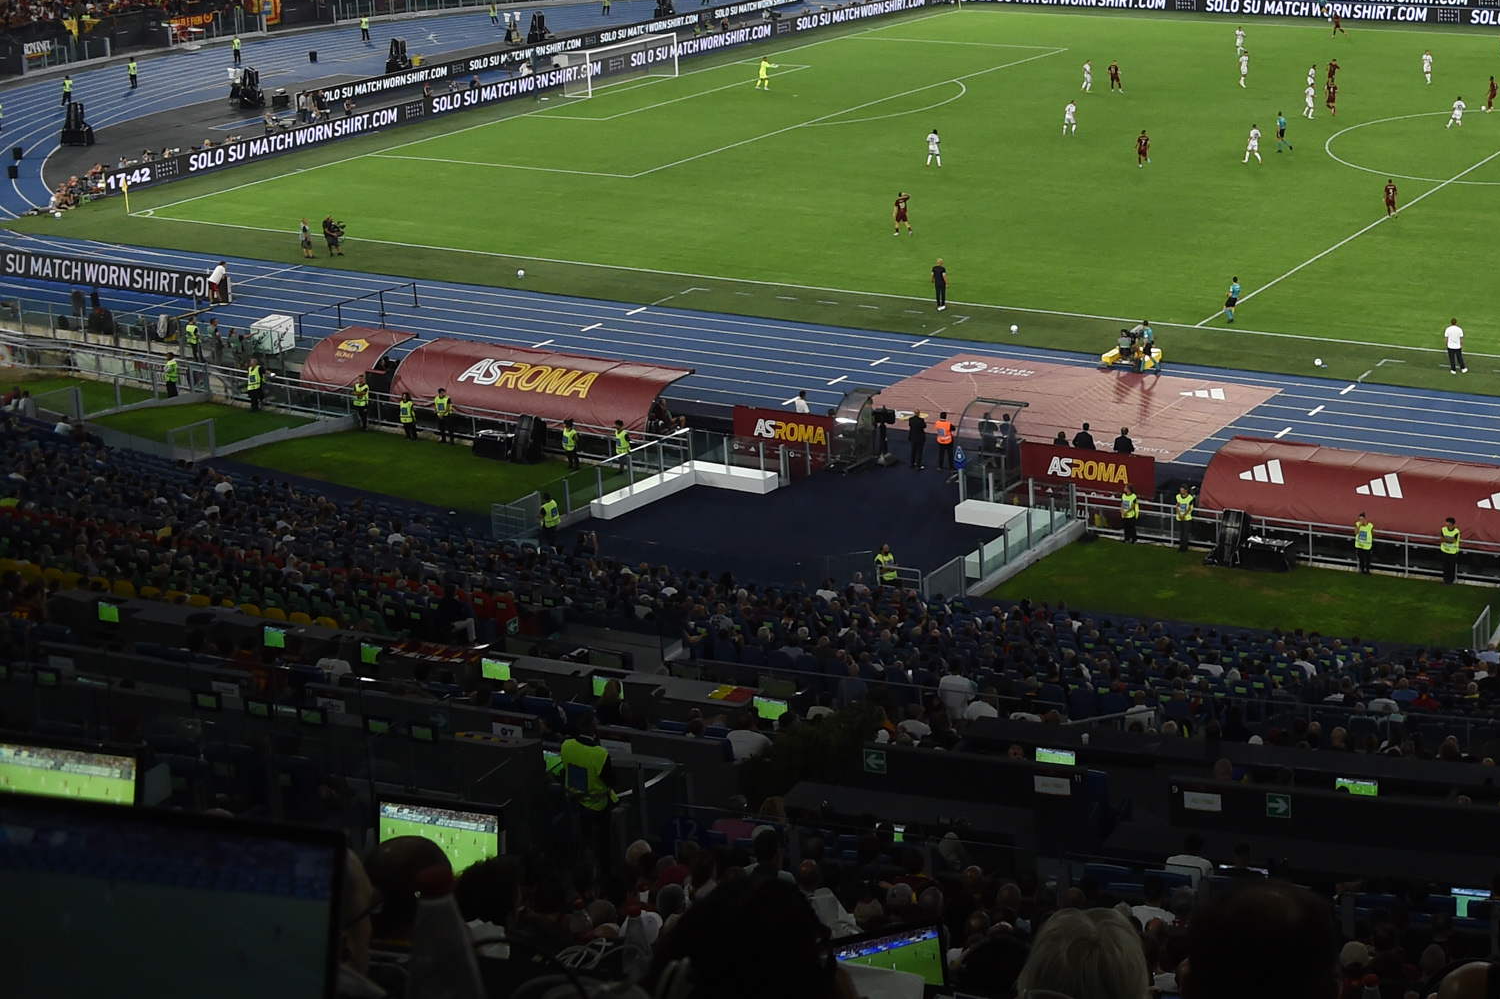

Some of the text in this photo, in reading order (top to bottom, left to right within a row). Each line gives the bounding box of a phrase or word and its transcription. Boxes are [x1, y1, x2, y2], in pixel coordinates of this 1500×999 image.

[1243, 0, 1260, 14] SU
[796, 15, 818, 30] SOLO
[820, 12, 831, 24] SU
[432, 94, 460, 113] SOLO
[464, 89, 478, 104] SU
[189, 150, 224, 171] SOLO
[228, 144, 246, 162] SU
[107, 168, 151, 190] 17:42
[6, 253, 25, 274] SU
[1172, 785, 1178, 793] 9
[673, 817, 698, 839] 12
